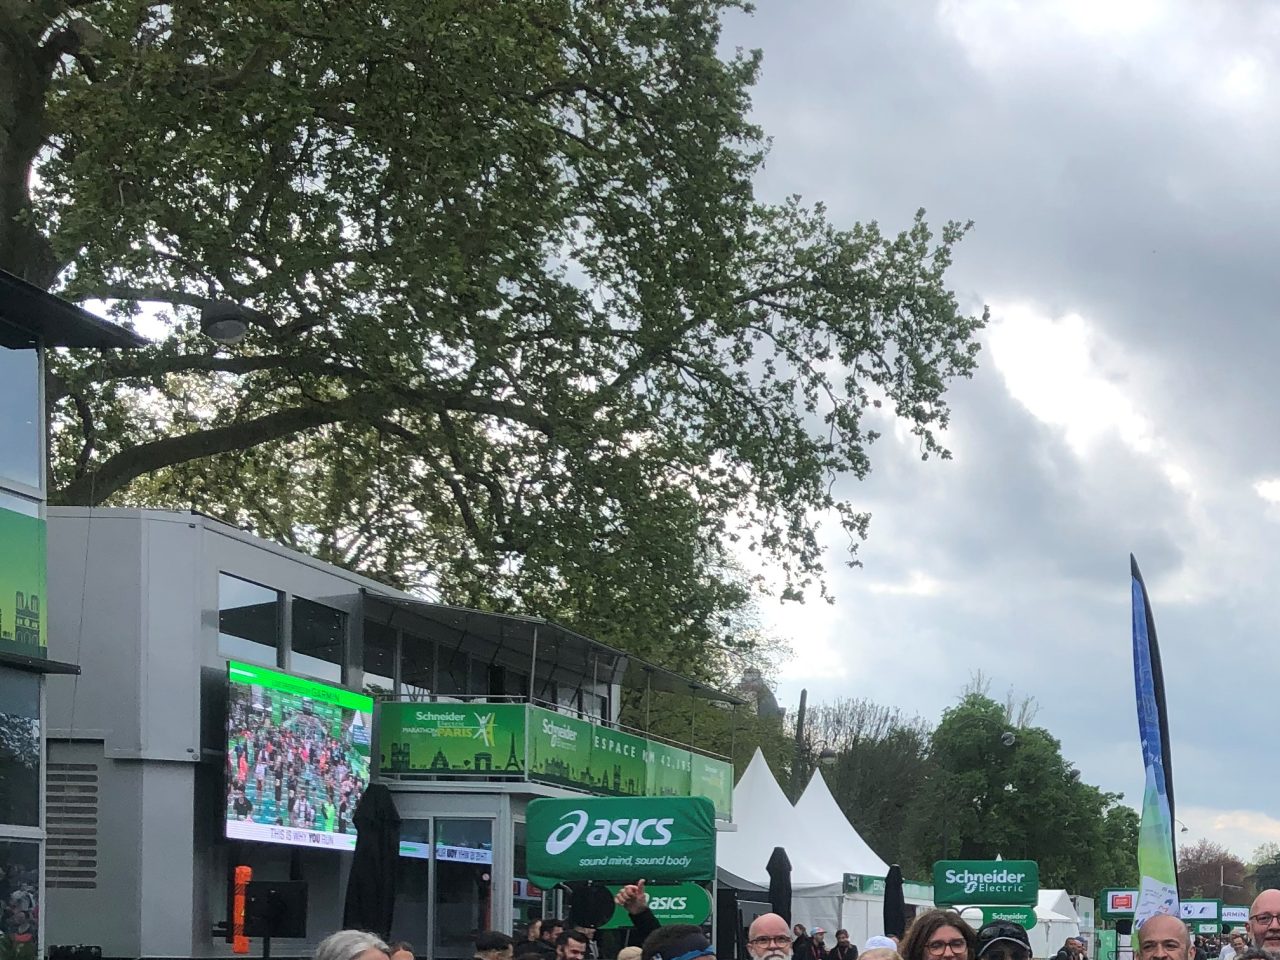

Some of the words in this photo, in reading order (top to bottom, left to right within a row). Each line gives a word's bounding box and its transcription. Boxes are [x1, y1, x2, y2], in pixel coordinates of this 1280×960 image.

[416, 711, 466, 721] Schneider
[437, 728, 472, 737] PARIS
[543, 718, 577, 741] Schneider
[594, 736, 636, 758] ESPACE
[270, 828, 285, 840] THIS
[286, 829, 292, 841] IS
[293, 830, 308, 842] WHY
[308, 832, 321, 844] YOU
[321, 833, 334, 845] RUN
[586, 818, 674, 846] asics
[579, 856, 607, 867] sound
[608, 855, 633, 867] mind,
[634, 855, 666, 866] sound
[666, 855, 691, 868] body
[945, 869, 1025, 884] Schneider
[978, 883, 1023, 892] Electric
[649, 896, 687, 910] asics
